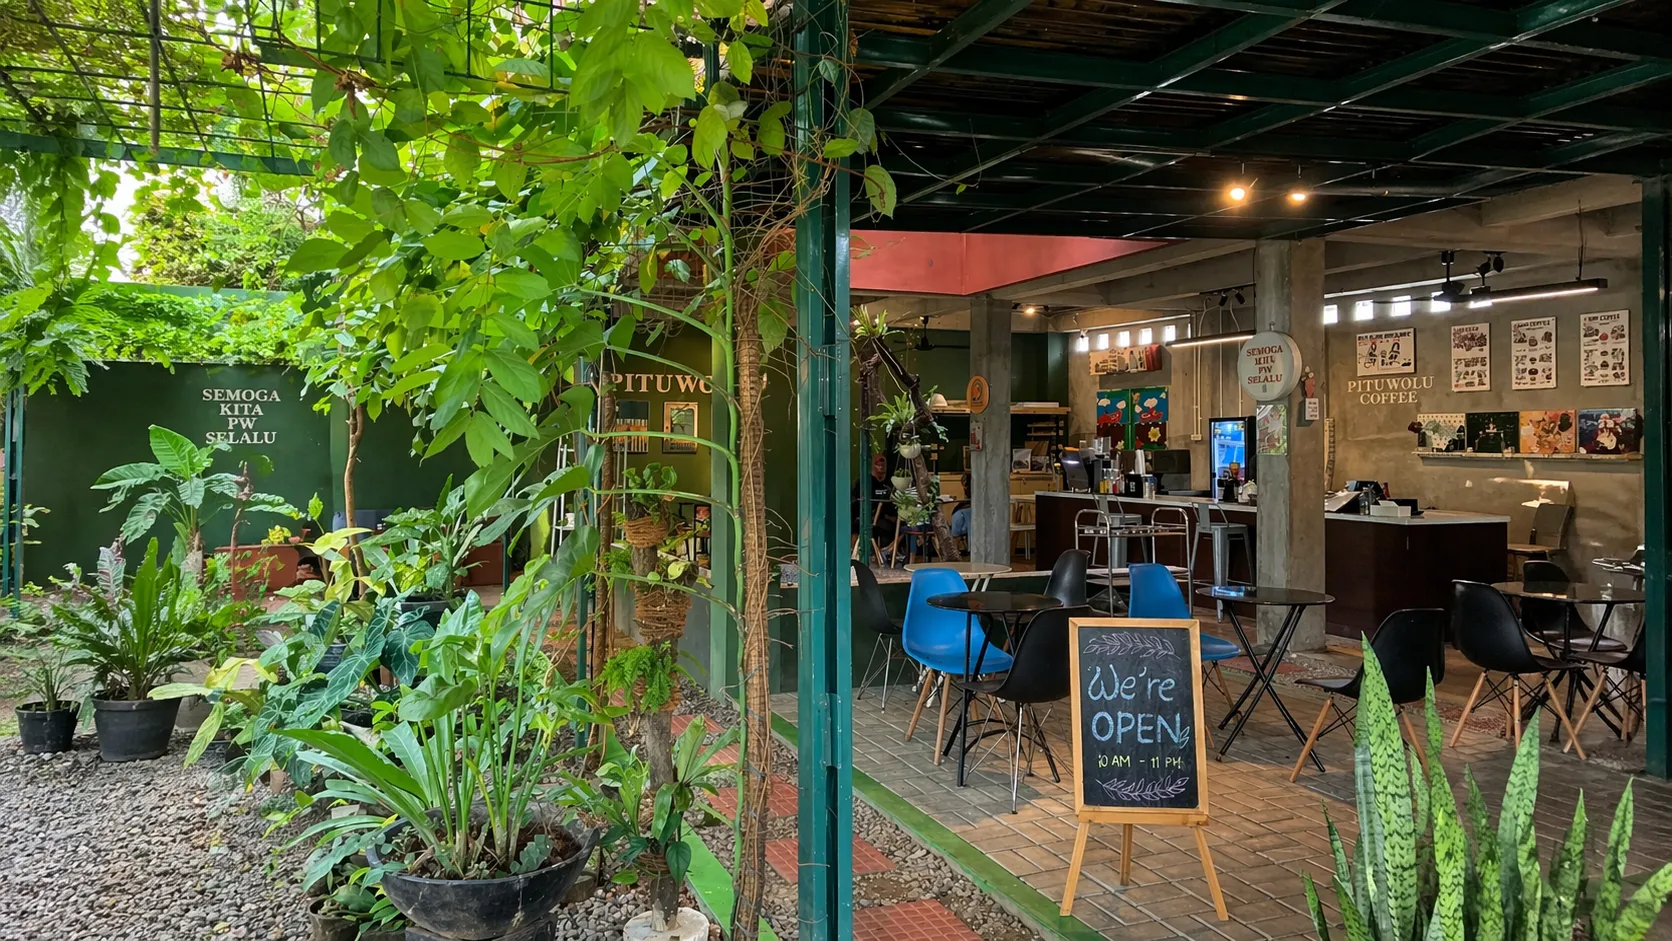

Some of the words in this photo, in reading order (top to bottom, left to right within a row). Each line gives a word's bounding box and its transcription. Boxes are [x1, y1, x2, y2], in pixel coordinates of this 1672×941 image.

[1247, 345, 1283, 357] SEMOGA
[1247, 373, 1283, 384] SELALU
[1347, 376, 1434, 393] PITUWOLU
[202, 388, 281, 402] SEMOGA
[1360, 391, 1418, 405] COFFEE
[219, 403, 264, 416] KITA
[227, 417, 257, 430] PW
[205, 431, 277, 444] SELALU
[1087, 663, 1176, 702] We're
[1091, 710, 1181, 744] OPEN
[1111, 755, 1131, 768] AM
[1150, 756, 1160, 768] 11
